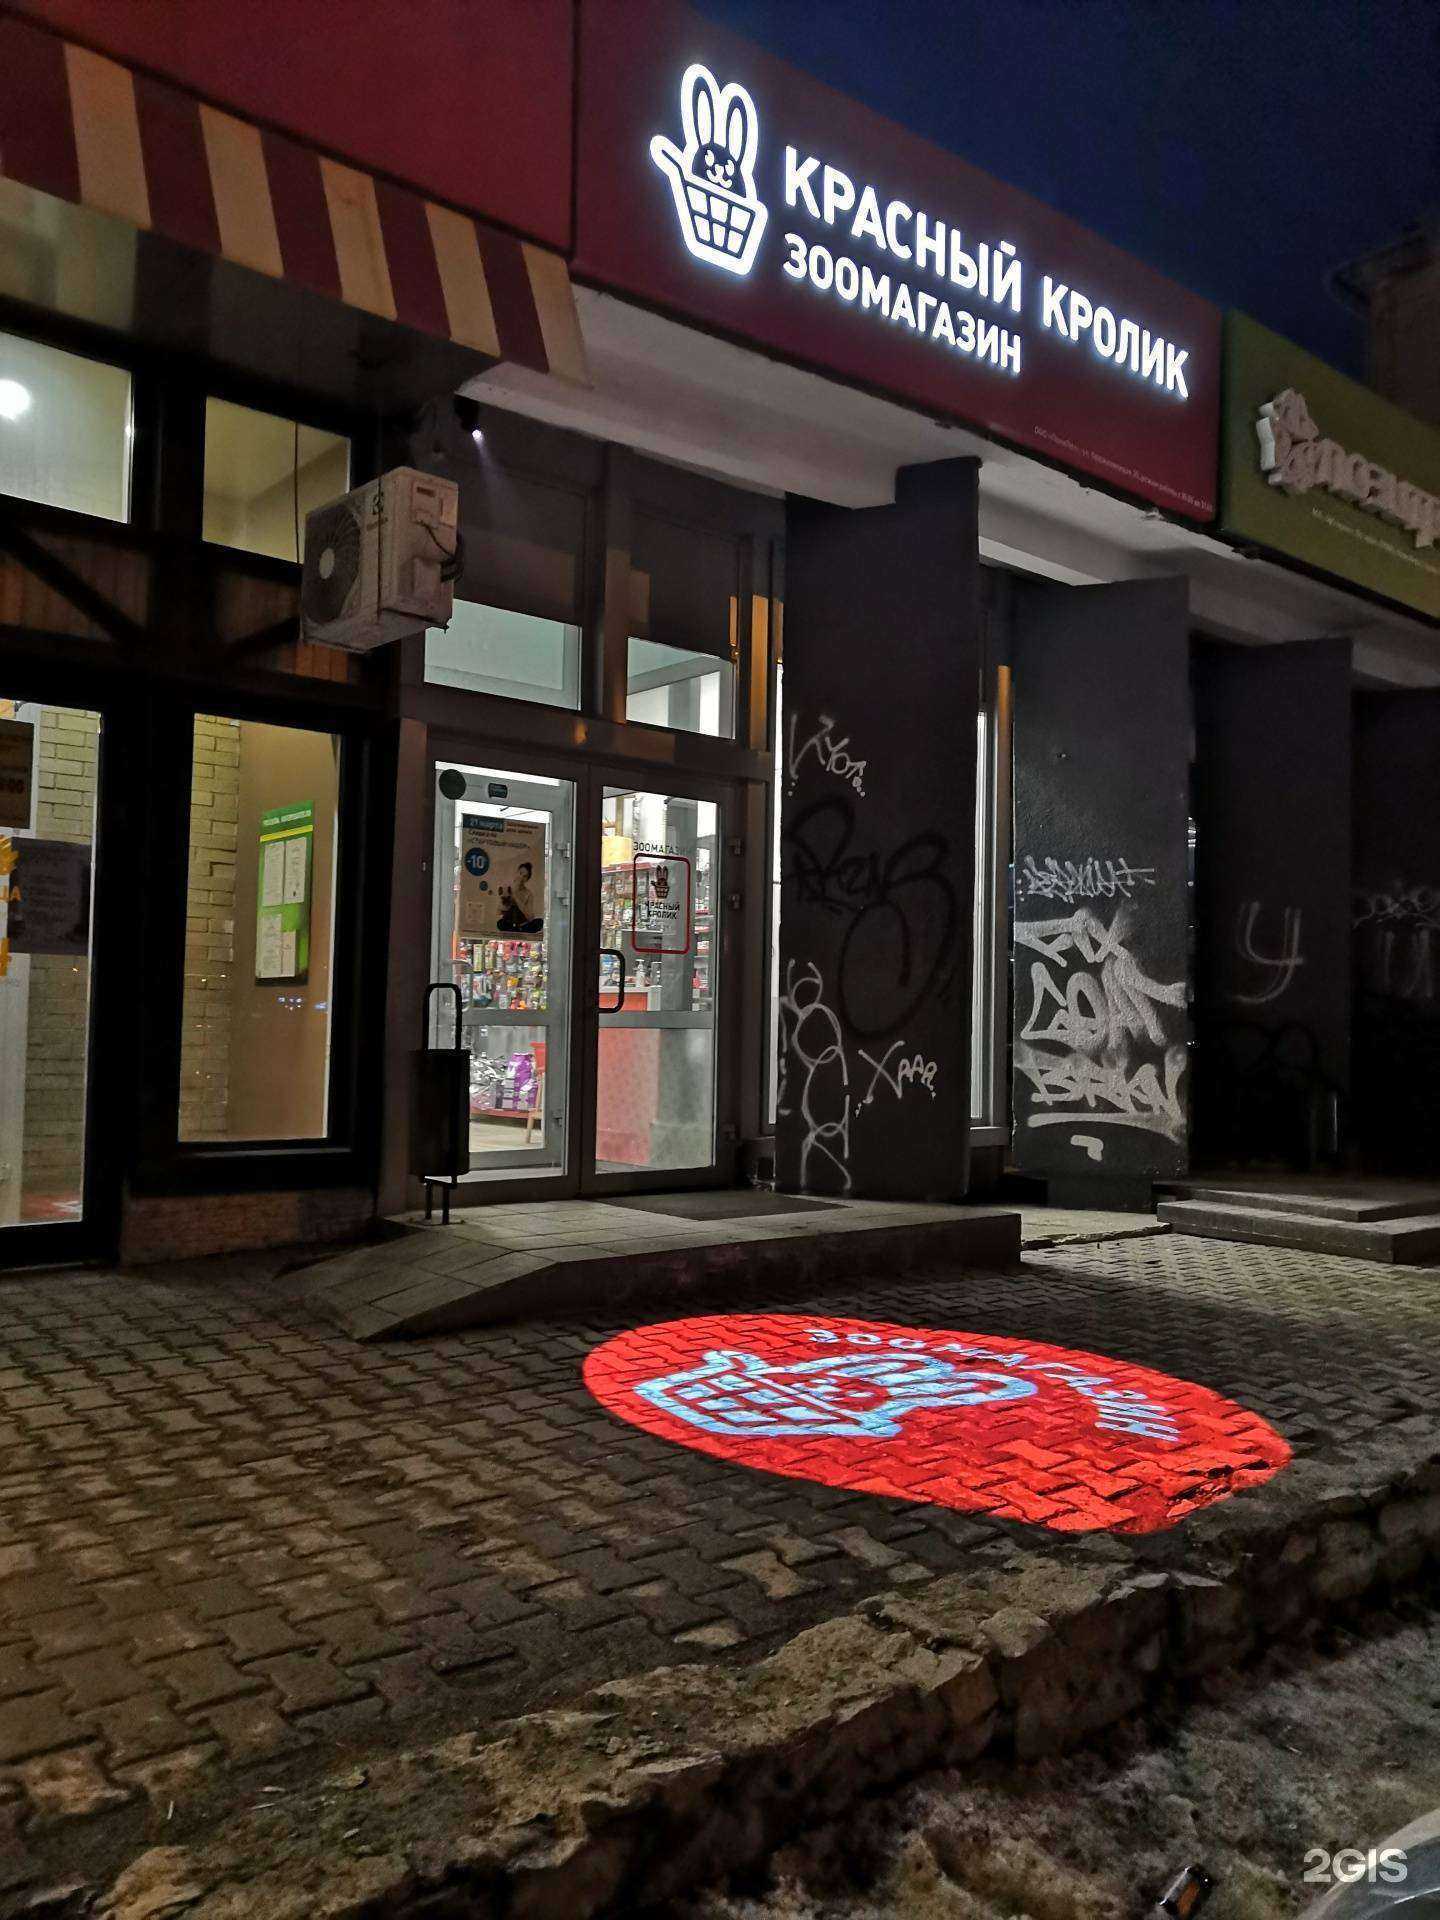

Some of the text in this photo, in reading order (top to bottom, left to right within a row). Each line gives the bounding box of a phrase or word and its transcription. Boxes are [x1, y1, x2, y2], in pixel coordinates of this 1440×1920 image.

[782, 232, 1022, 374] ЗООМАГАЗИН
[784, 145, 1189, 399] КРАСНЫЙ КРОЛИК
